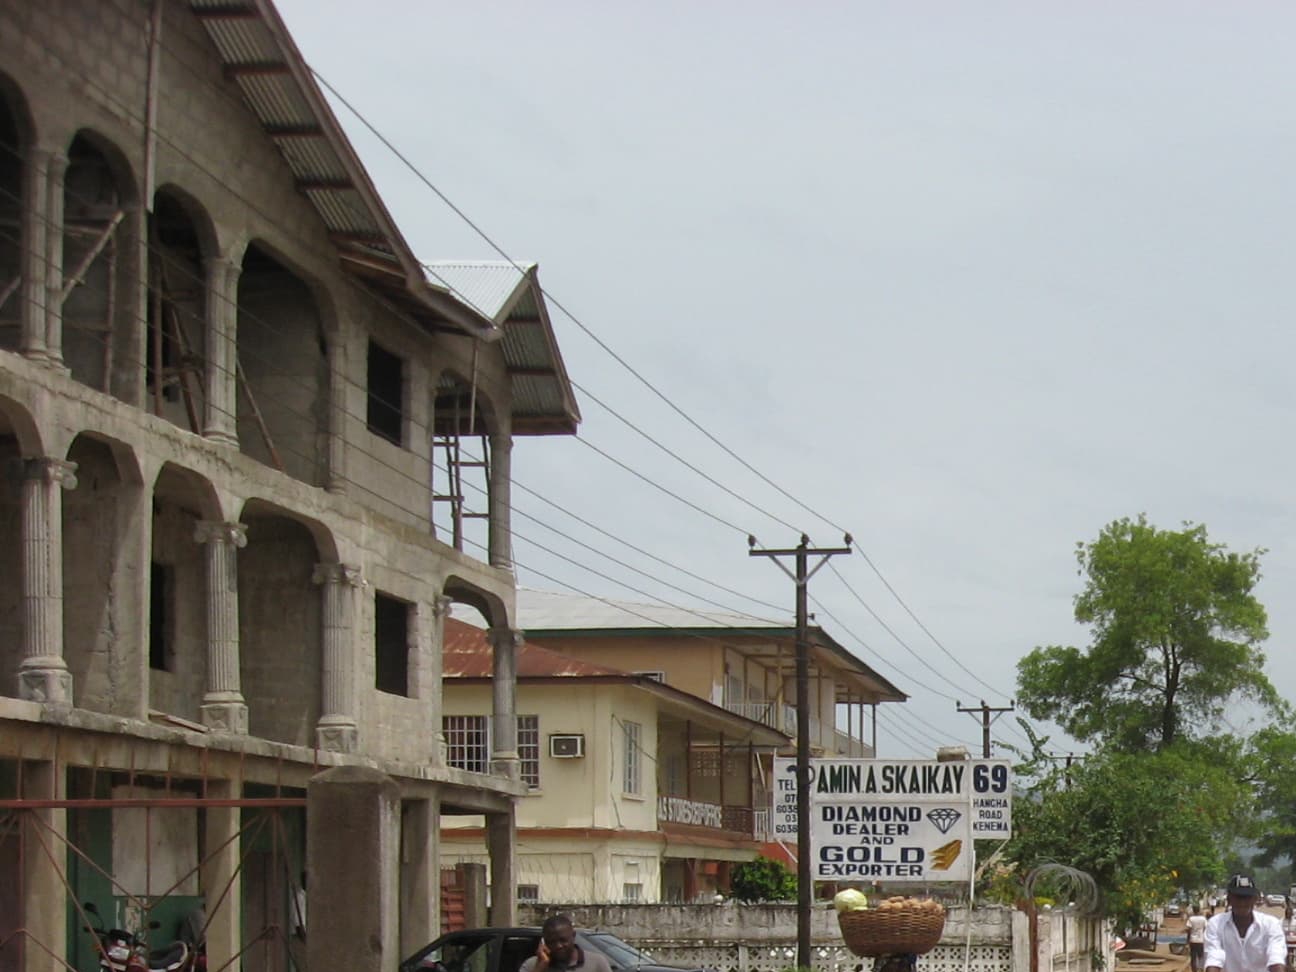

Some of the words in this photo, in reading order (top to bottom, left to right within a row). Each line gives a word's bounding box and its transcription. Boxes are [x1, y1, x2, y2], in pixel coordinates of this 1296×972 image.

[973, 764, 1008, 793] 69
[822, 806, 922, 822] DIAMOND
[979, 810, 1003, 820] ROAD
[833, 823, 909, 836] DEALER
[972, 821, 1008, 832] KENEMA
[860, 836, 894, 846] AND
[820, 846, 925, 863] GOLD
[819, 863, 923, 877] EXPORTER
